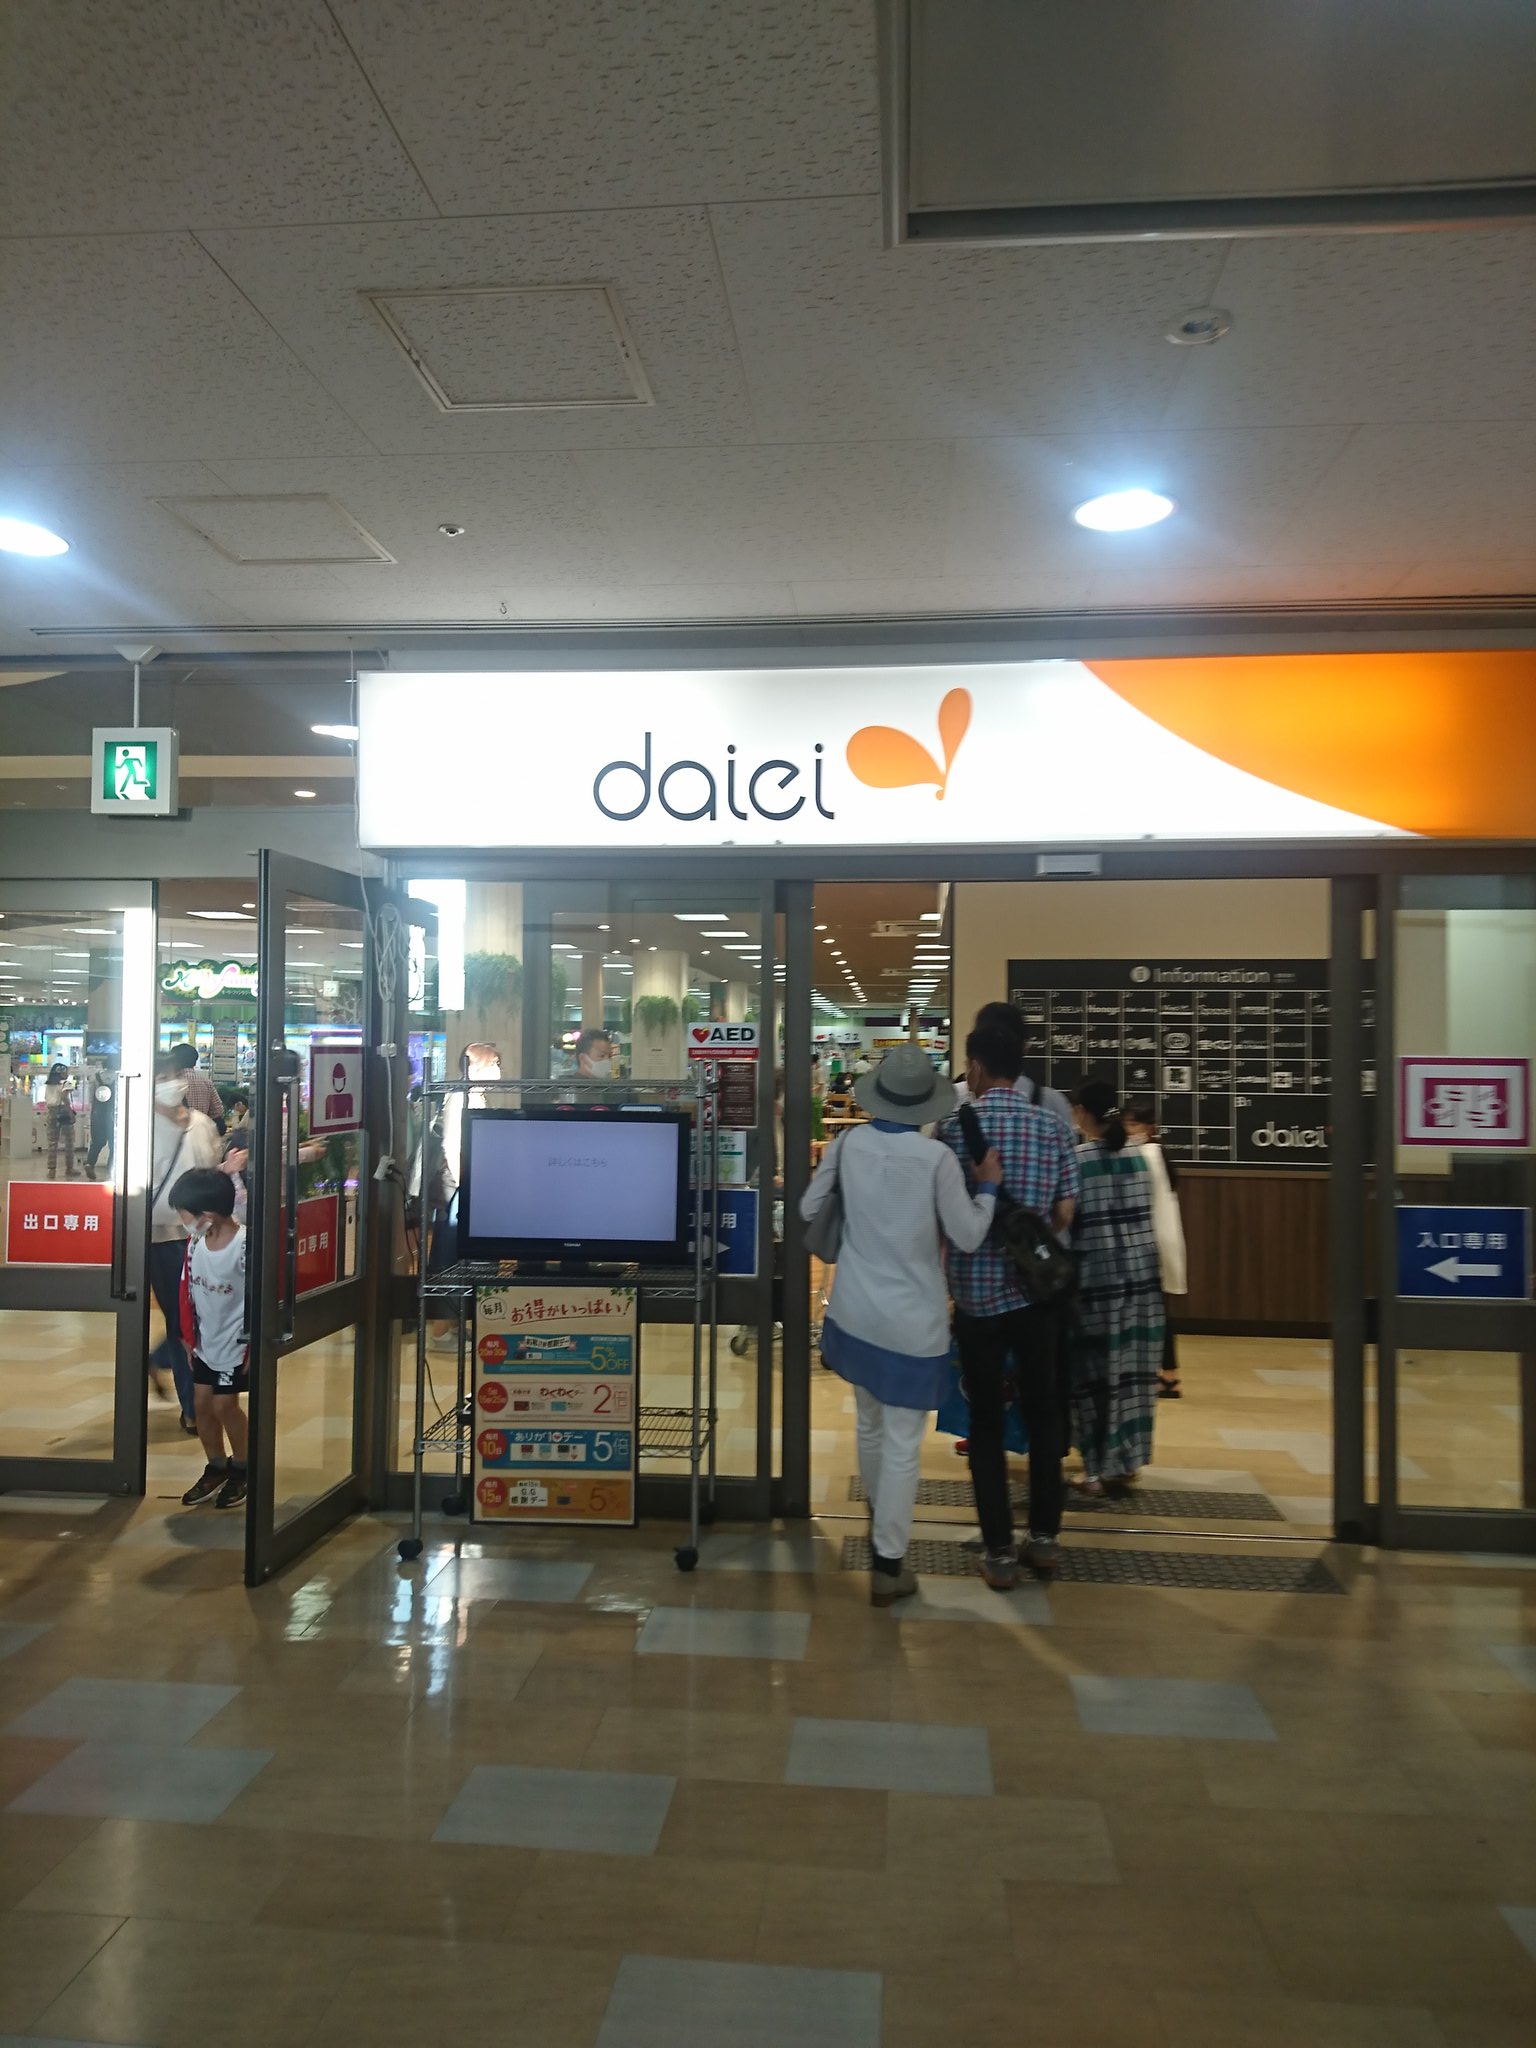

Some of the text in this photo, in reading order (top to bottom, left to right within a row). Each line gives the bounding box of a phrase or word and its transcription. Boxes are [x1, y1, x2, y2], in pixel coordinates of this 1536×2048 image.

[593, 732, 835, 821] daiei
[1152, 966, 1271, 984] Information
[710, 1027, 755, 1041] AED
[23, 1213, 99, 1232] 出口専用
[1416, 1231, 1508, 1250] 入口専用
[482, 1301, 503, 1315] 毎月
